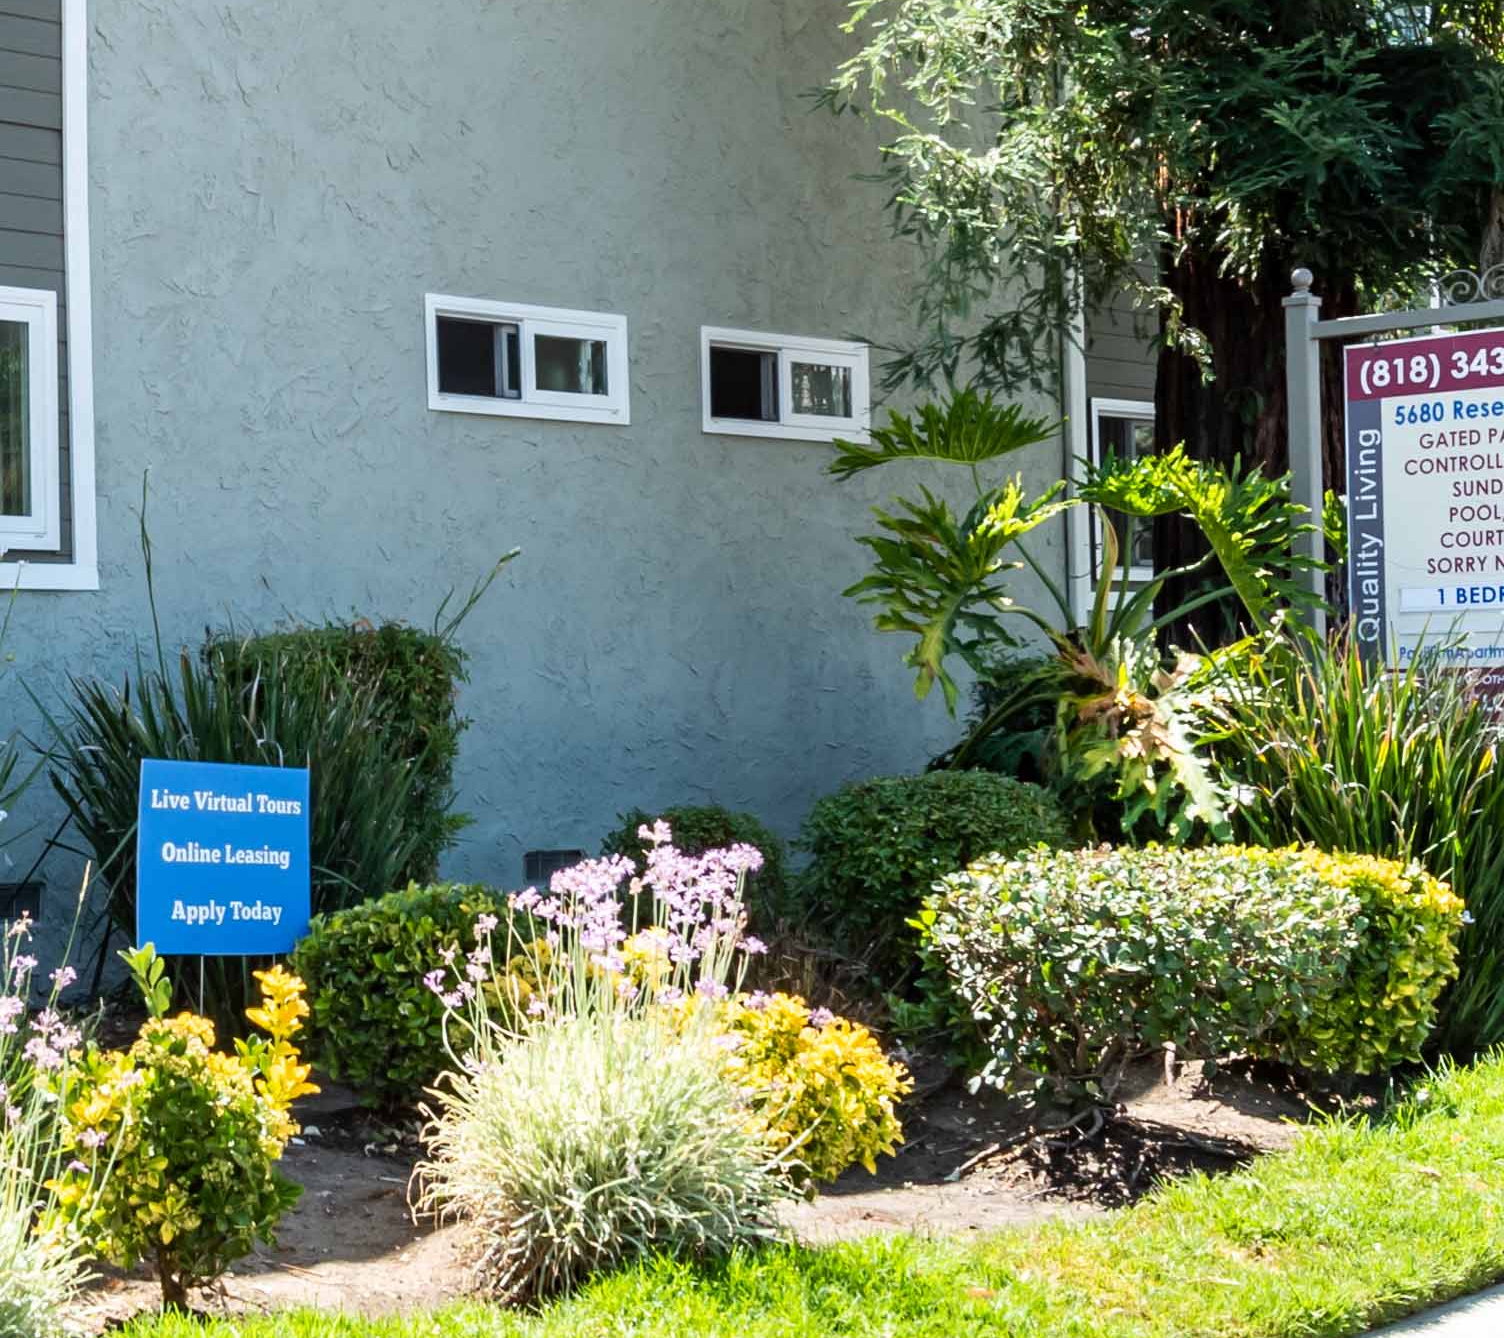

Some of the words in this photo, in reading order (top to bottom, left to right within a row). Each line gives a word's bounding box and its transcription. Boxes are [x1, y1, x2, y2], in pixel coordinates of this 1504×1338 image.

[1359, 353, 1441, 395] (818)
[1394, 402, 1444, 426] 5680
[1419, 429, 1481, 450] GATED
[1354, 429, 1381, 521] Living
[1427, 557, 1488, 575] SORRY
[1356, 533, 1384, 642] Quality
[1438, 588, 1445, 605] 1
[151, 789, 190, 810] Live
[194, 791, 253, 813] Virtual
[256, 794, 301, 815] Tours
[161, 842, 221, 863] Online
[225, 845, 290, 869] Leasing
[171, 900, 226, 925] Apply
[230, 900, 282, 925] Today
